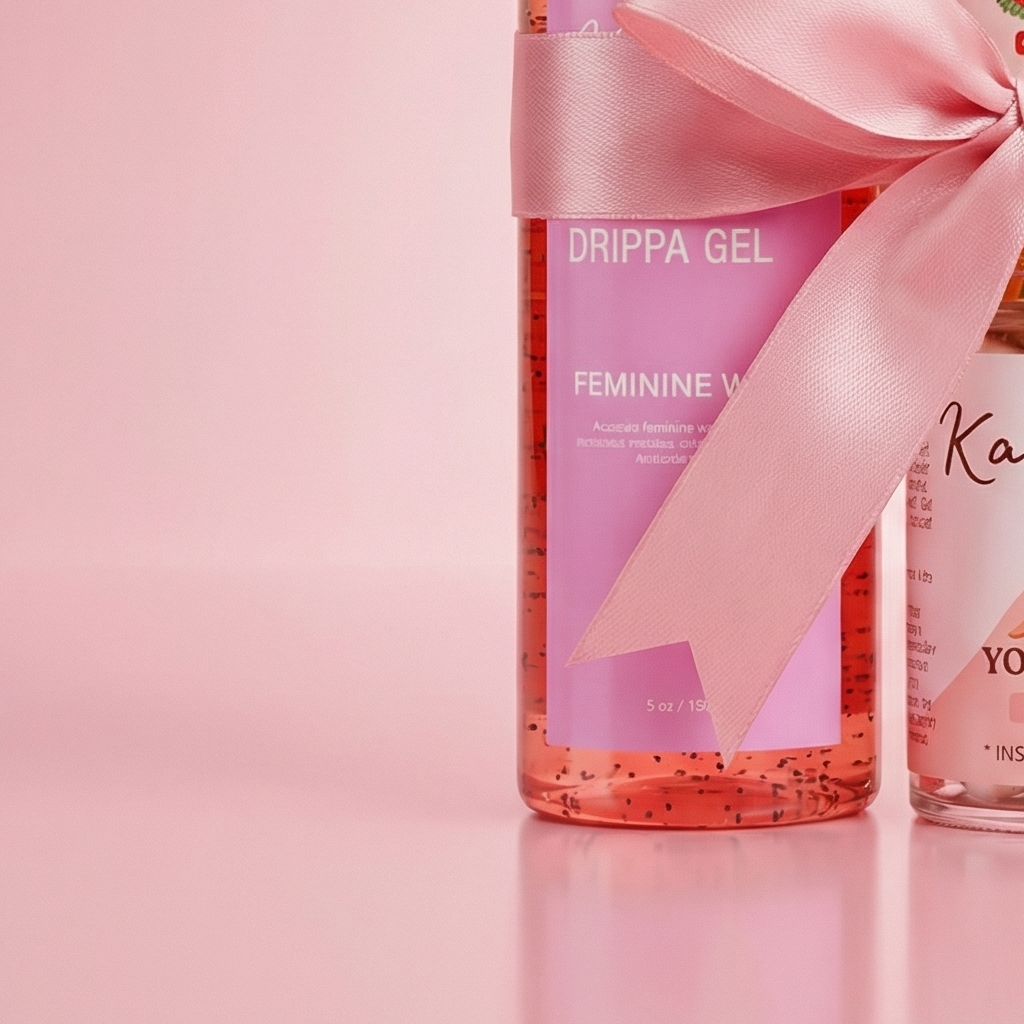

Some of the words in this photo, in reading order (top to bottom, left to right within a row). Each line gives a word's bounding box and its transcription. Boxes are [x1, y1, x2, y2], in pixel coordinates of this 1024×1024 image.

[568, 228, 690, 264] DRIPPA
[704, 228, 774, 264] GEL
[574, 371, 712, 397] FEMININE
[647, 699, 655, 712] 5
[658, 702, 673, 712] oz
